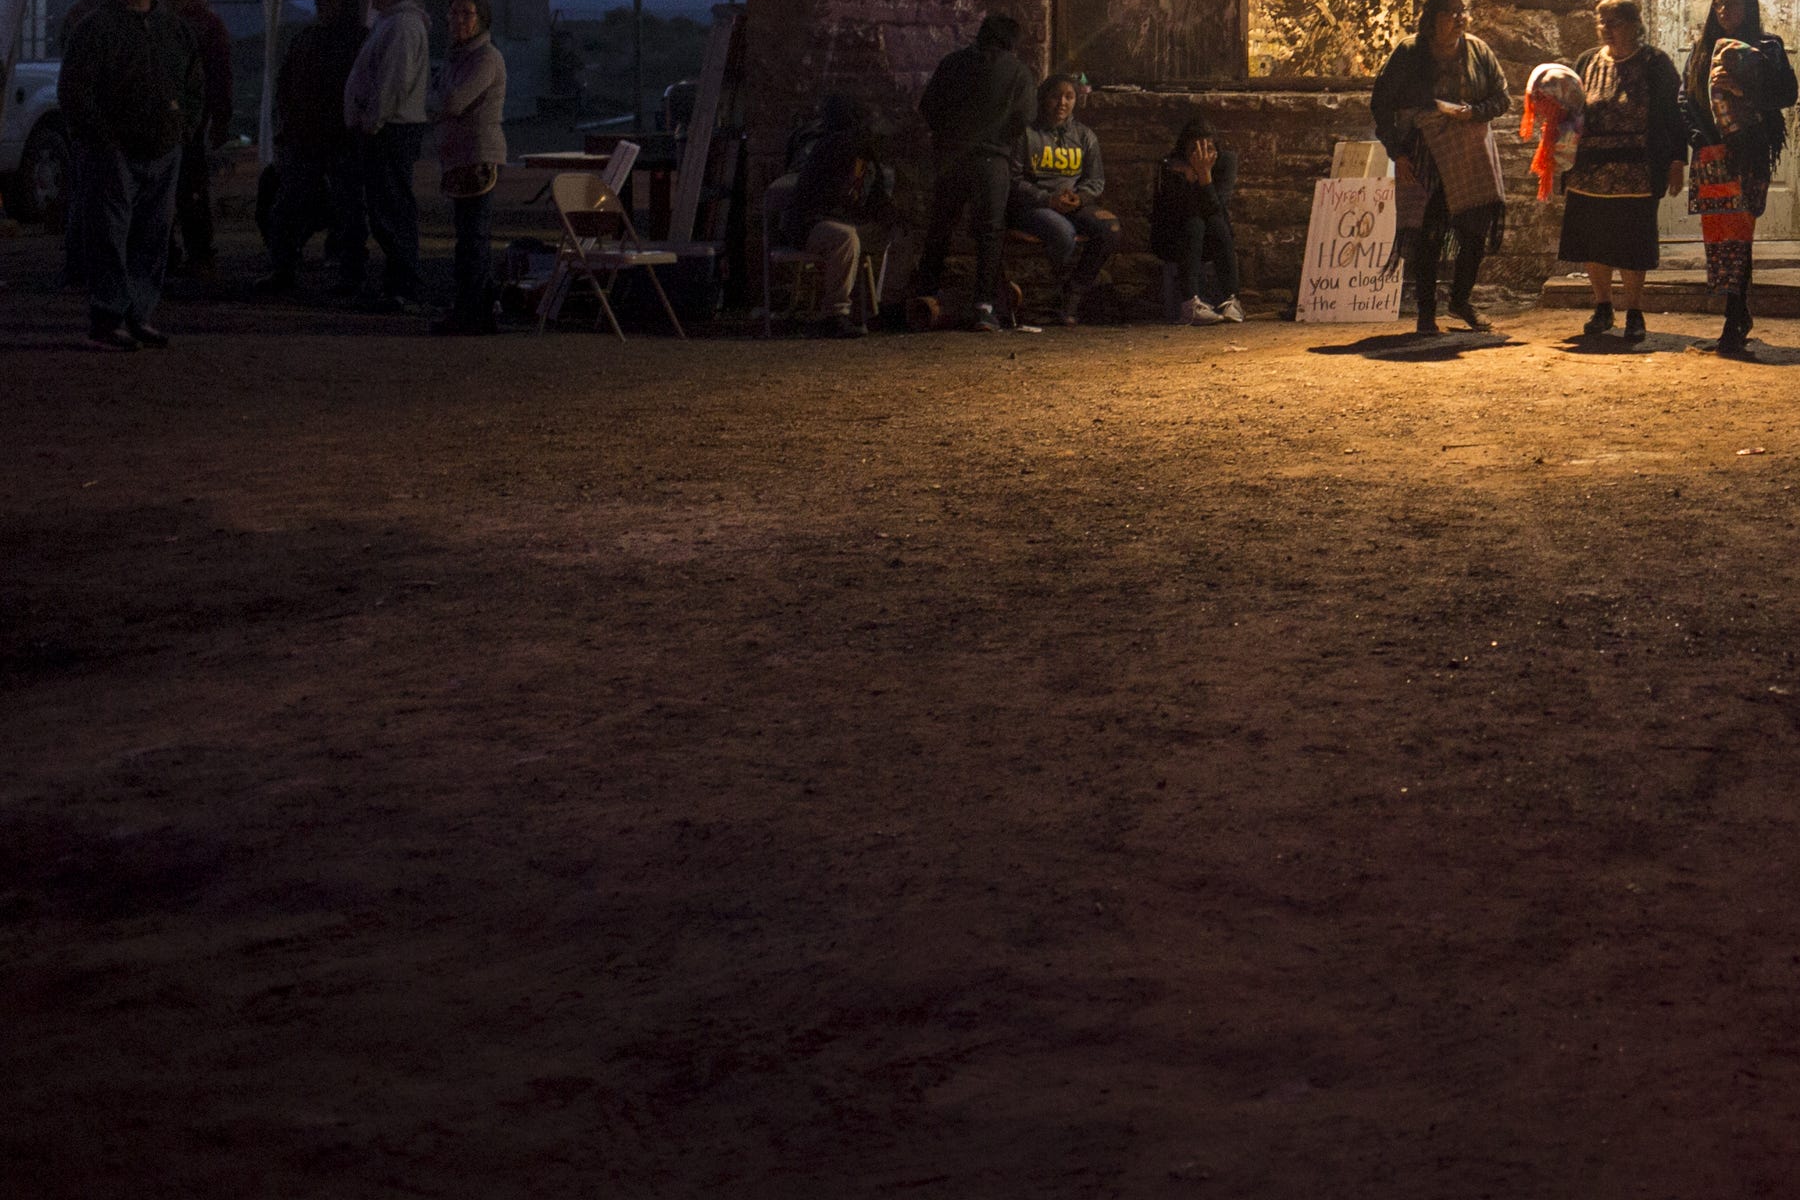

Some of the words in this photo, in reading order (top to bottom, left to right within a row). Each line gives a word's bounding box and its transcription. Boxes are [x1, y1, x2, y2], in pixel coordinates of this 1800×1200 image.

[1040, 145, 1082, 170] ASU
[1373, 188, 1394, 206] sai
[1338, 210, 1375, 238] GO
[1318, 239, 1392, 269] HOME
[1310, 276, 1339, 295] you
[1348, 270, 1400, 292] clogged
[1306, 295, 1337, 311] the
